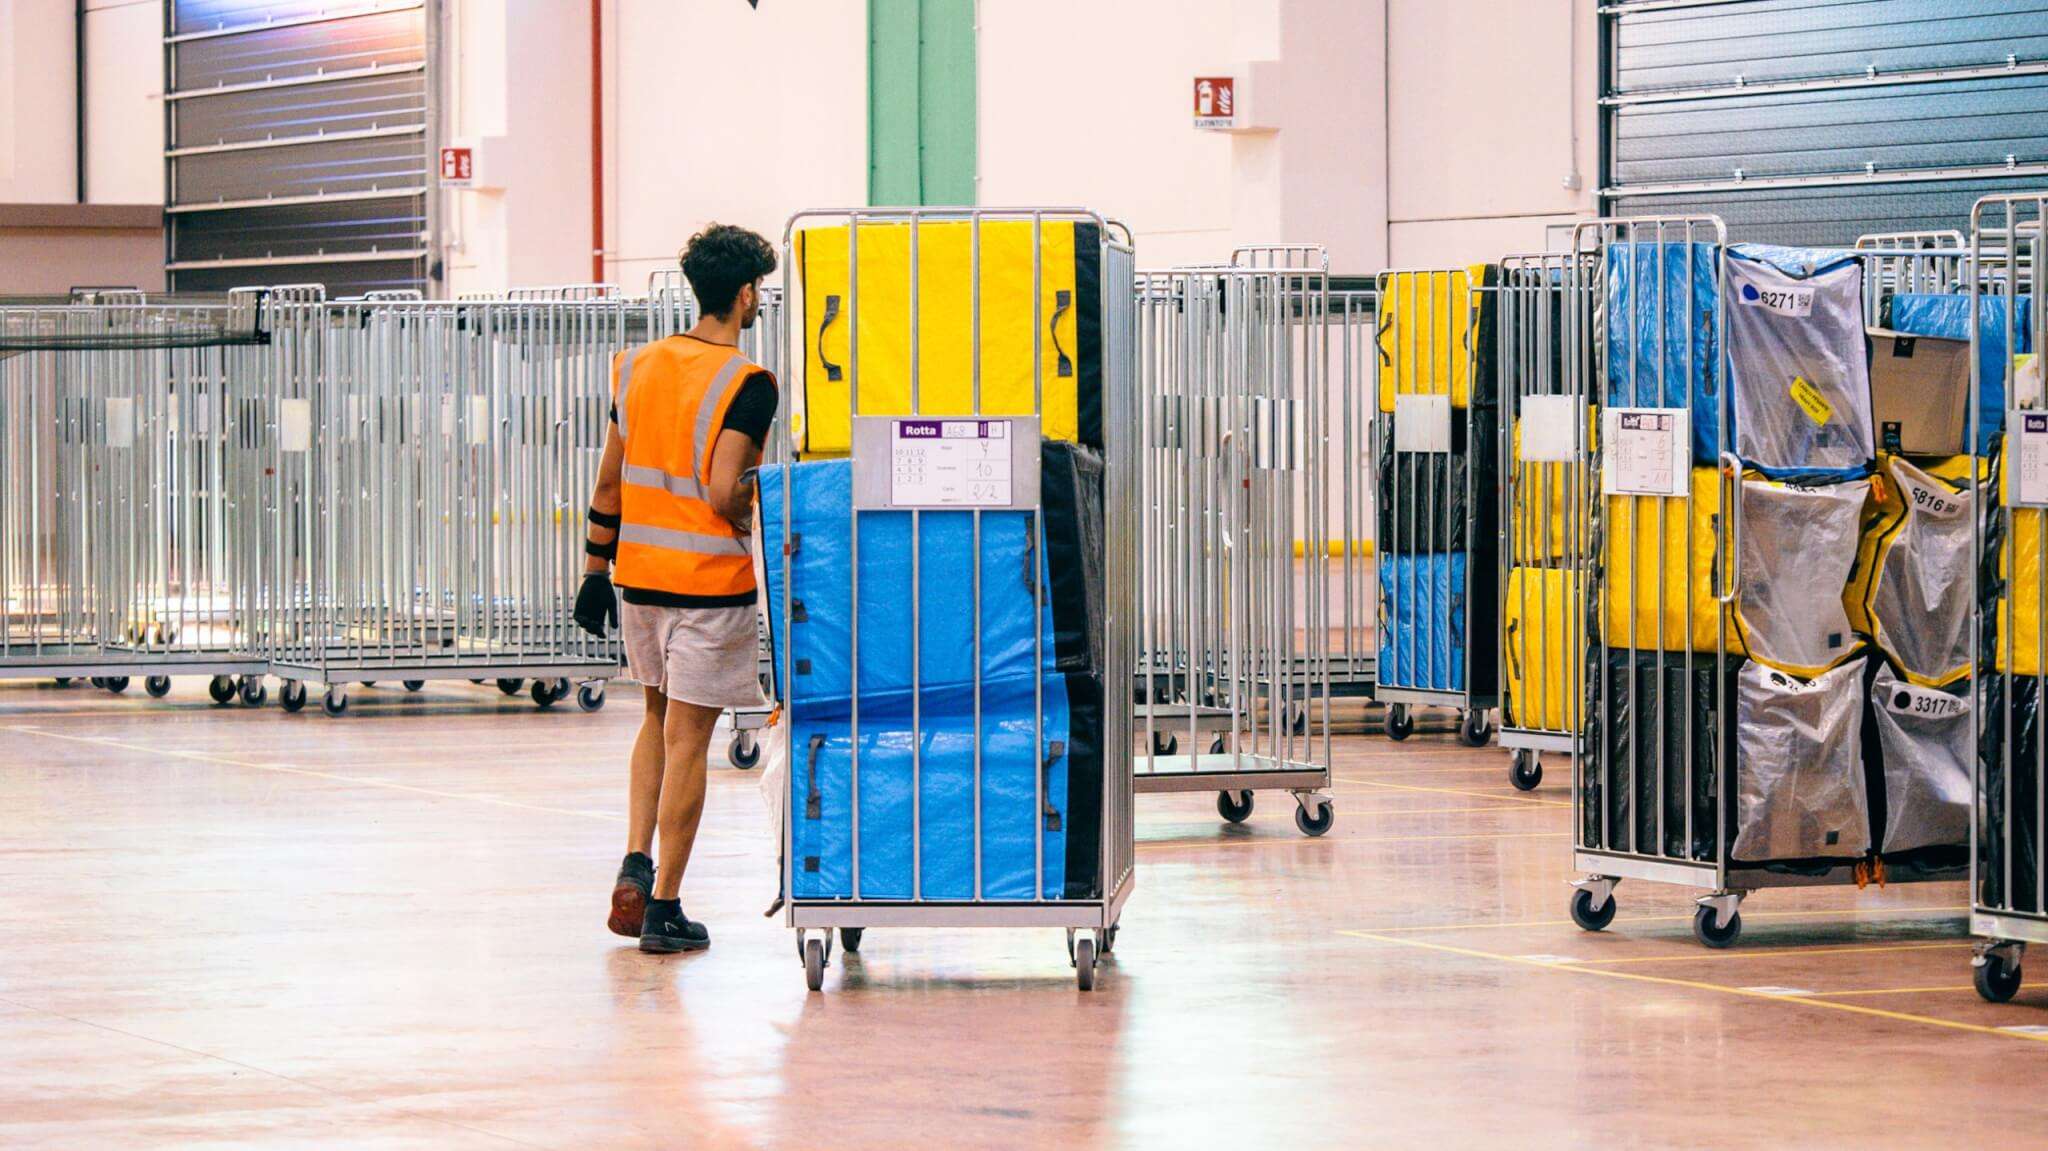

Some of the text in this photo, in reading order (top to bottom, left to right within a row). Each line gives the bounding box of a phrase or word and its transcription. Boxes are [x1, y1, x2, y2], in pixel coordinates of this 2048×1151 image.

[1760, 291, 1794, 310] 6271
[905, 425, 937, 436] Rotta
[1912, 487, 1945, 511] 5816
[1915, 696, 1948, 714] 3317
